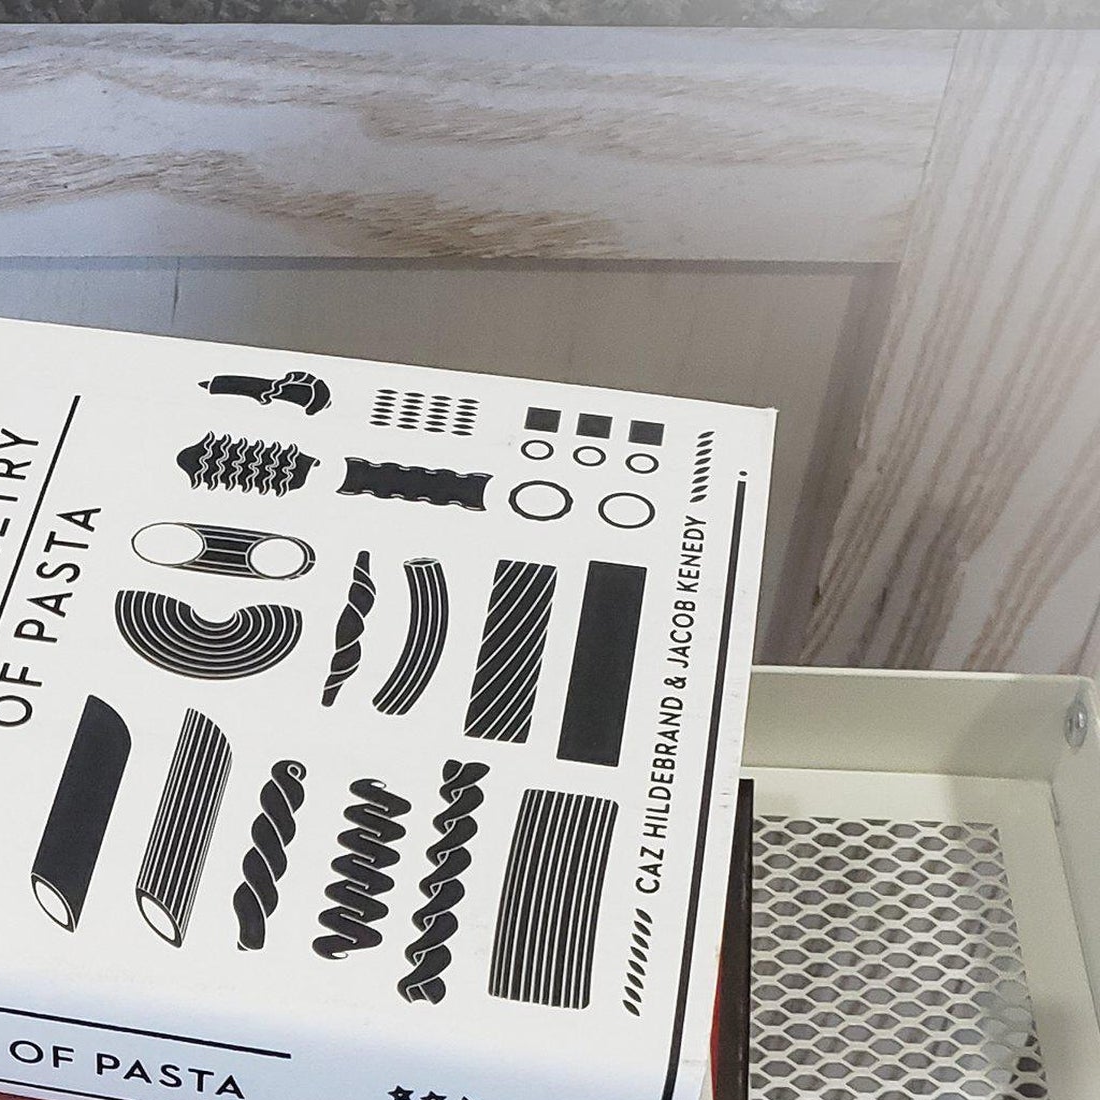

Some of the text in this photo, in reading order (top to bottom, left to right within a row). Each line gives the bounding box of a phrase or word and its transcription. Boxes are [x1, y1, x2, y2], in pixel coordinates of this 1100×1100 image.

[14, 507, 101, 643] PASTA
[635, 515, 707, 894] CAZ HILDEBRAND & JACOB KENEDY
[9, 1040, 75, 1068] OF
[96, 1052, 245, 1100] PASTA
